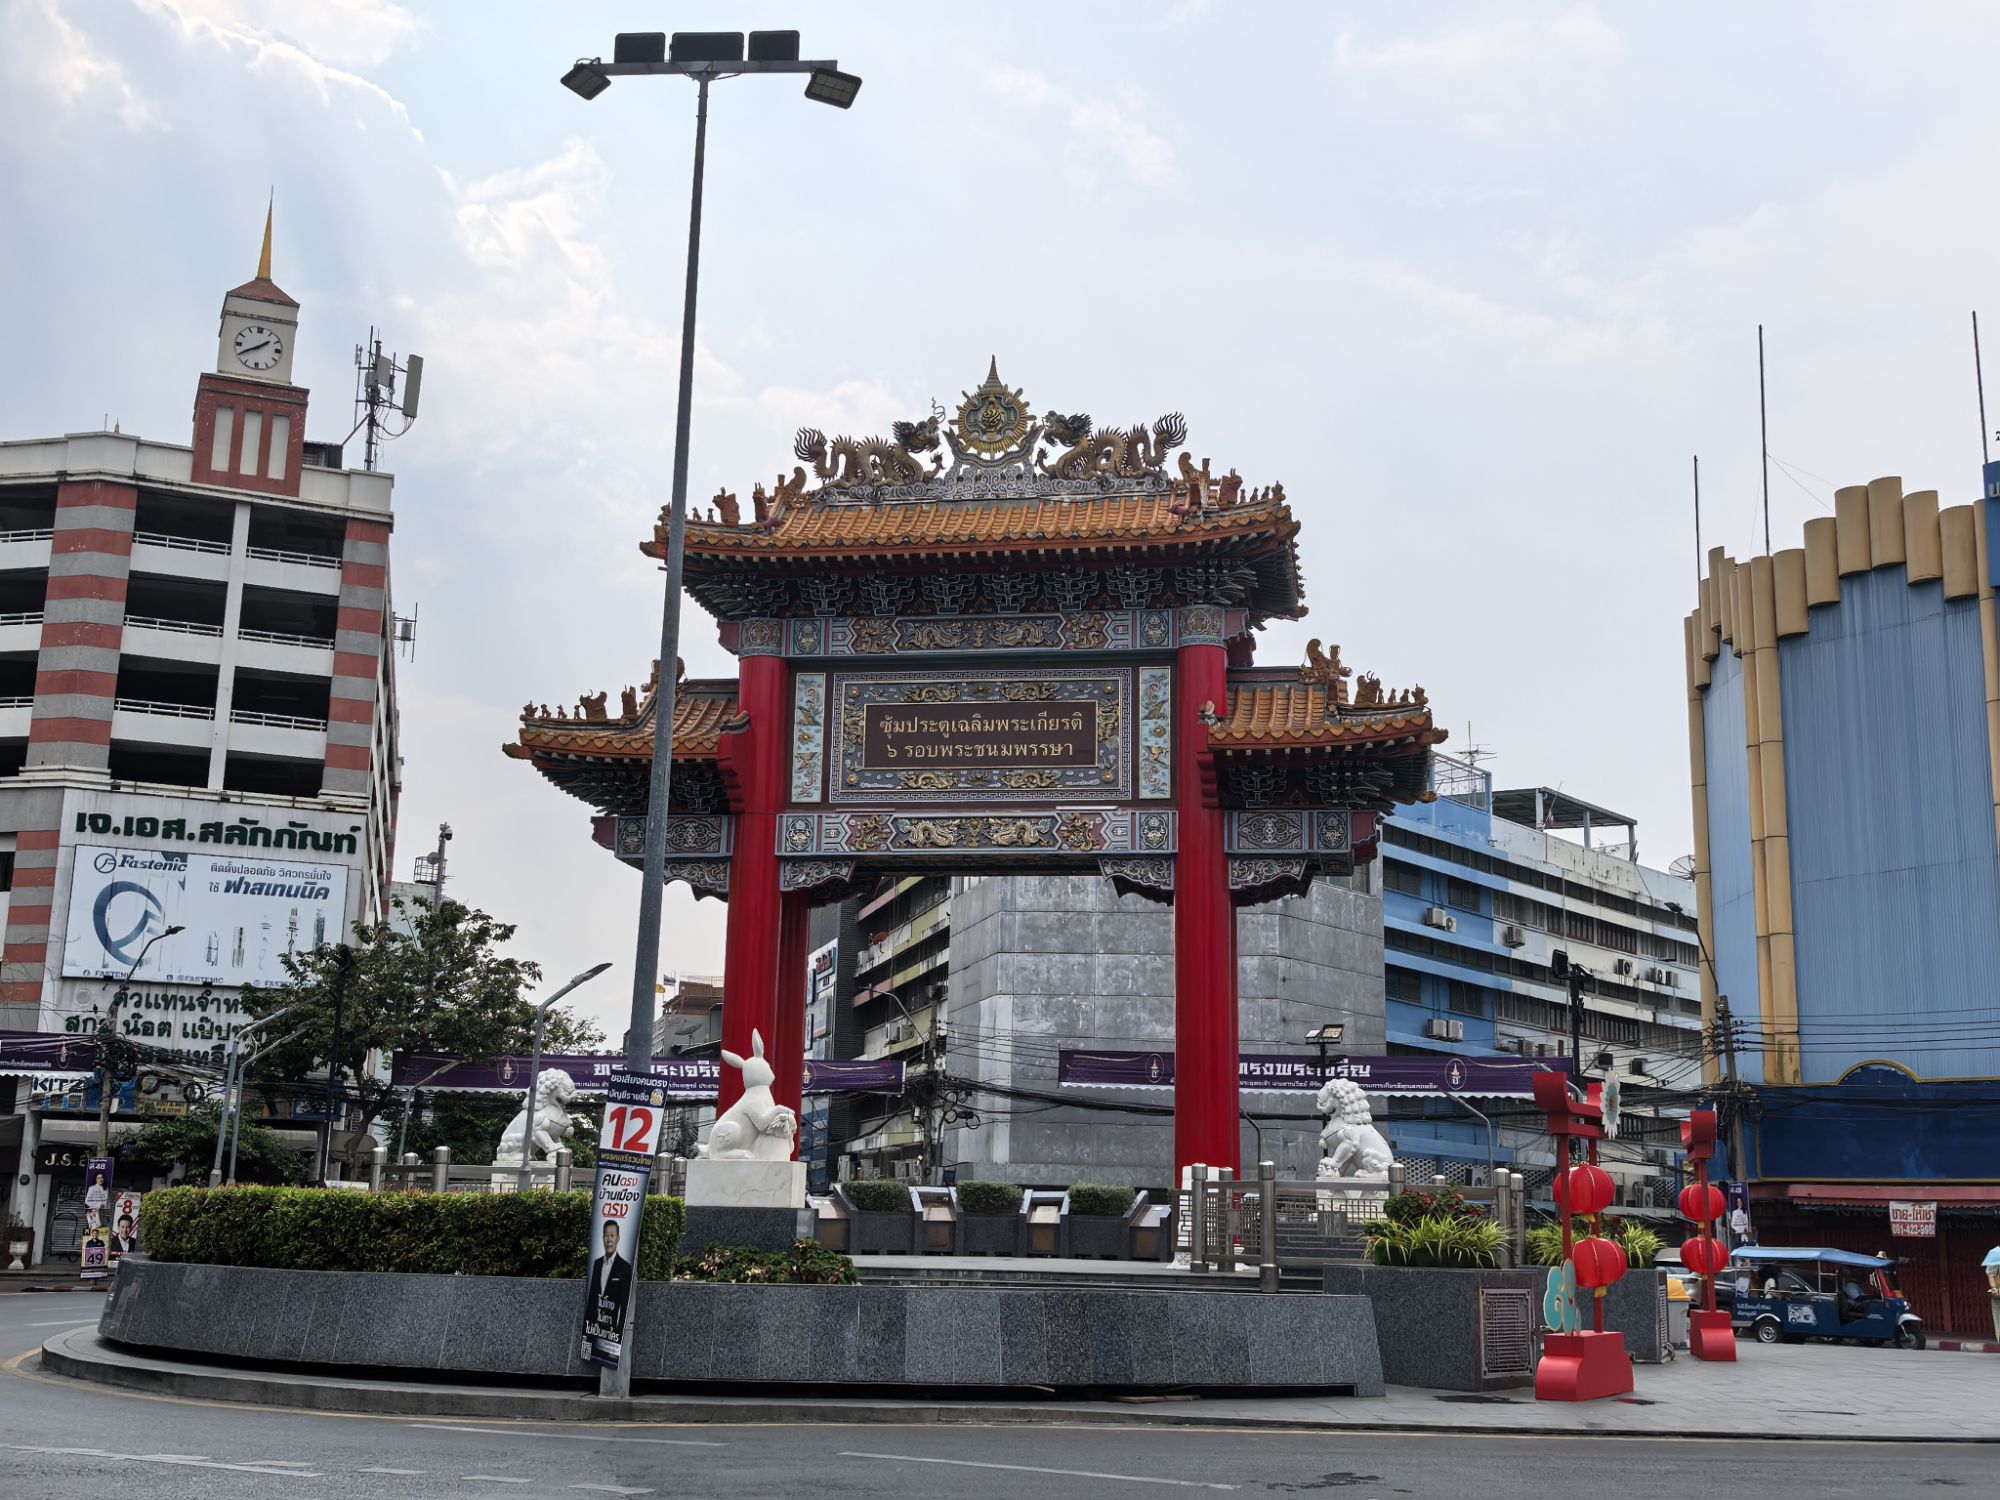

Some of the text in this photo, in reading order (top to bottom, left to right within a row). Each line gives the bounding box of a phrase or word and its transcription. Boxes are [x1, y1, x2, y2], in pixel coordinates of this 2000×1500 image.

[880, 711, 1083, 739] ซุ้มประตูเฉลิมพระเกียรติ
[887, 741, 1073, 758] ๖ รอบพระชนมพรรษา
[75, 812, 362, 855] เจ.เอส.สลักภัณฑ์
[118, 854, 188, 872] Fastenic
[210, 861, 276, 877] ติดตั้งปลอดภัย
[209, 876, 330, 900] ใช้ ฟาสเทนนิค
[33, 1077, 84, 1093] KITZ
[611, 1074, 668, 1088] ขอเสียงคนตรง
[608, 1106, 653, 1153] 12
[45, 1153, 76, 1167] J.S.
[598, 1187, 640, 1202] บ้านเมือง
[122, 1200, 132, 1214] 8
[601, 1202, 629, 1218] ตรง
[86, 1253, 104, 1265] 49
